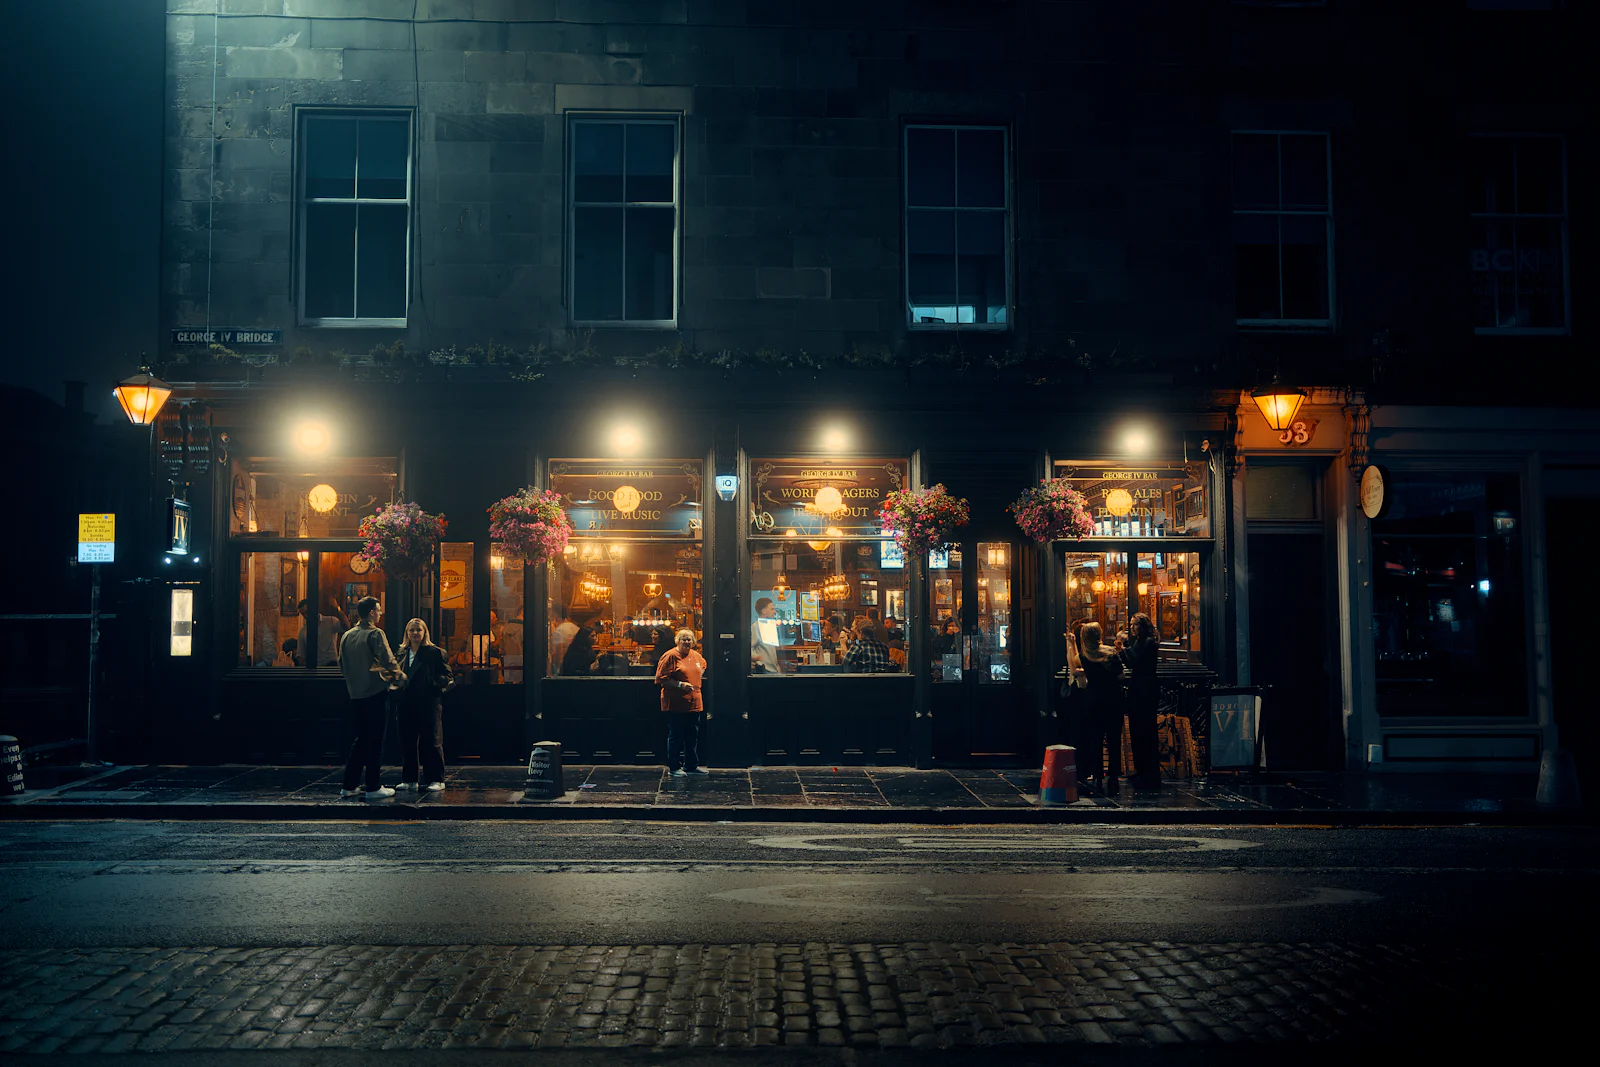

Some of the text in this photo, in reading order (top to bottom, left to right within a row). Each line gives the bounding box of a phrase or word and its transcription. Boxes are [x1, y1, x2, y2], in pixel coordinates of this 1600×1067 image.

[177, 331, 216, 343] GEORGE
[597, 470, 627, 478] GEORGE
[628, 470, 638, 478] IV
[801, 470, 831, 478] GEORGE
[832, 470, 842, 478] IV
[1102, 472, 1158, 480] GEORGE IV BAR
[336, 494, 359, 504] GIN
[588, 490, 664, 501] GOOD FOOD
[837, 488, 880, 499] AGERS
[1133, 488, 1162, 499] ALES
[591, 510, 661, 521] LIVE MUSIC
[174, 514, 189, 542] IV
